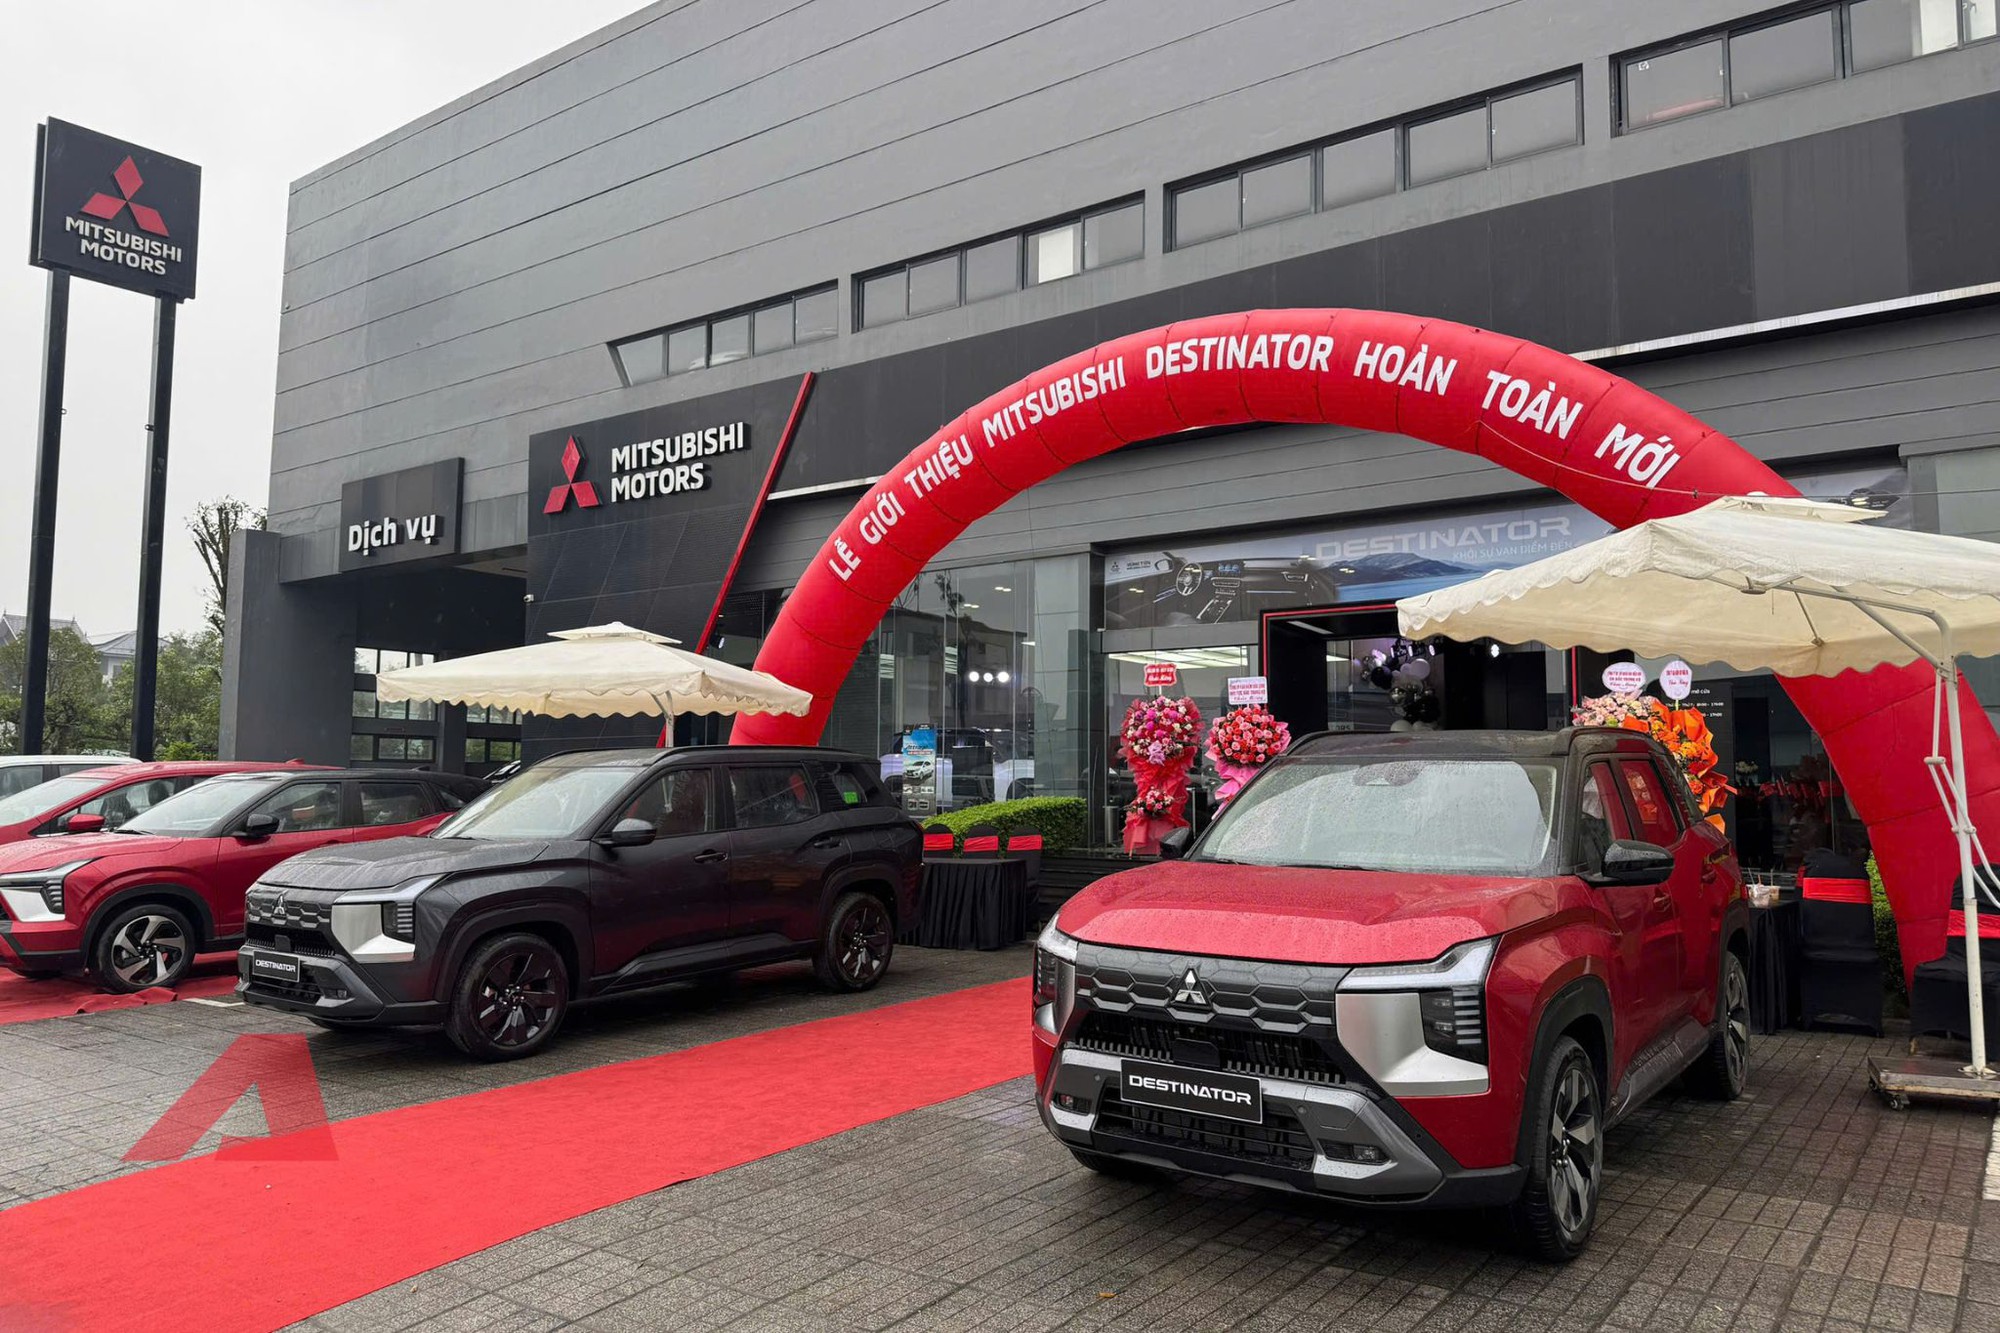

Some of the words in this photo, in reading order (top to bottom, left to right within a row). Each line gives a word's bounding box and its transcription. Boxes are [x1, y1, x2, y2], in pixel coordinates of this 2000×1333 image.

[65, 215, 182, 263] MITSUBISHI
[80, 238, 167, 276] MOTORS
[611, 421, 745, 474] MITSUBISHI
[828, 537, 861, 581] LỄ
[859, 490, 906, 546] GIỚI
[903, 433, 974, 499] THIỆU
[981, 355, 1127, 448] MITSUBISHI
[1145, 333, 1335, 379] DESTINATOR
[1353, 340, 1458, 397] HOÀN
[1481, 369, 1584, 441] TOÀN
[1594, 421, 1681, 490] MỚI
[611, 462, 705, 504] MOTORS
[347, 520, 397, 556] Dịch
[405, 514, 437, 546] vụ
[1316, 516, 1572, 560] DESTINATOR
[255, 959, 296, 973] DESTINATOR
[1128, 1074, 1253, 1107] DESTINATOR
